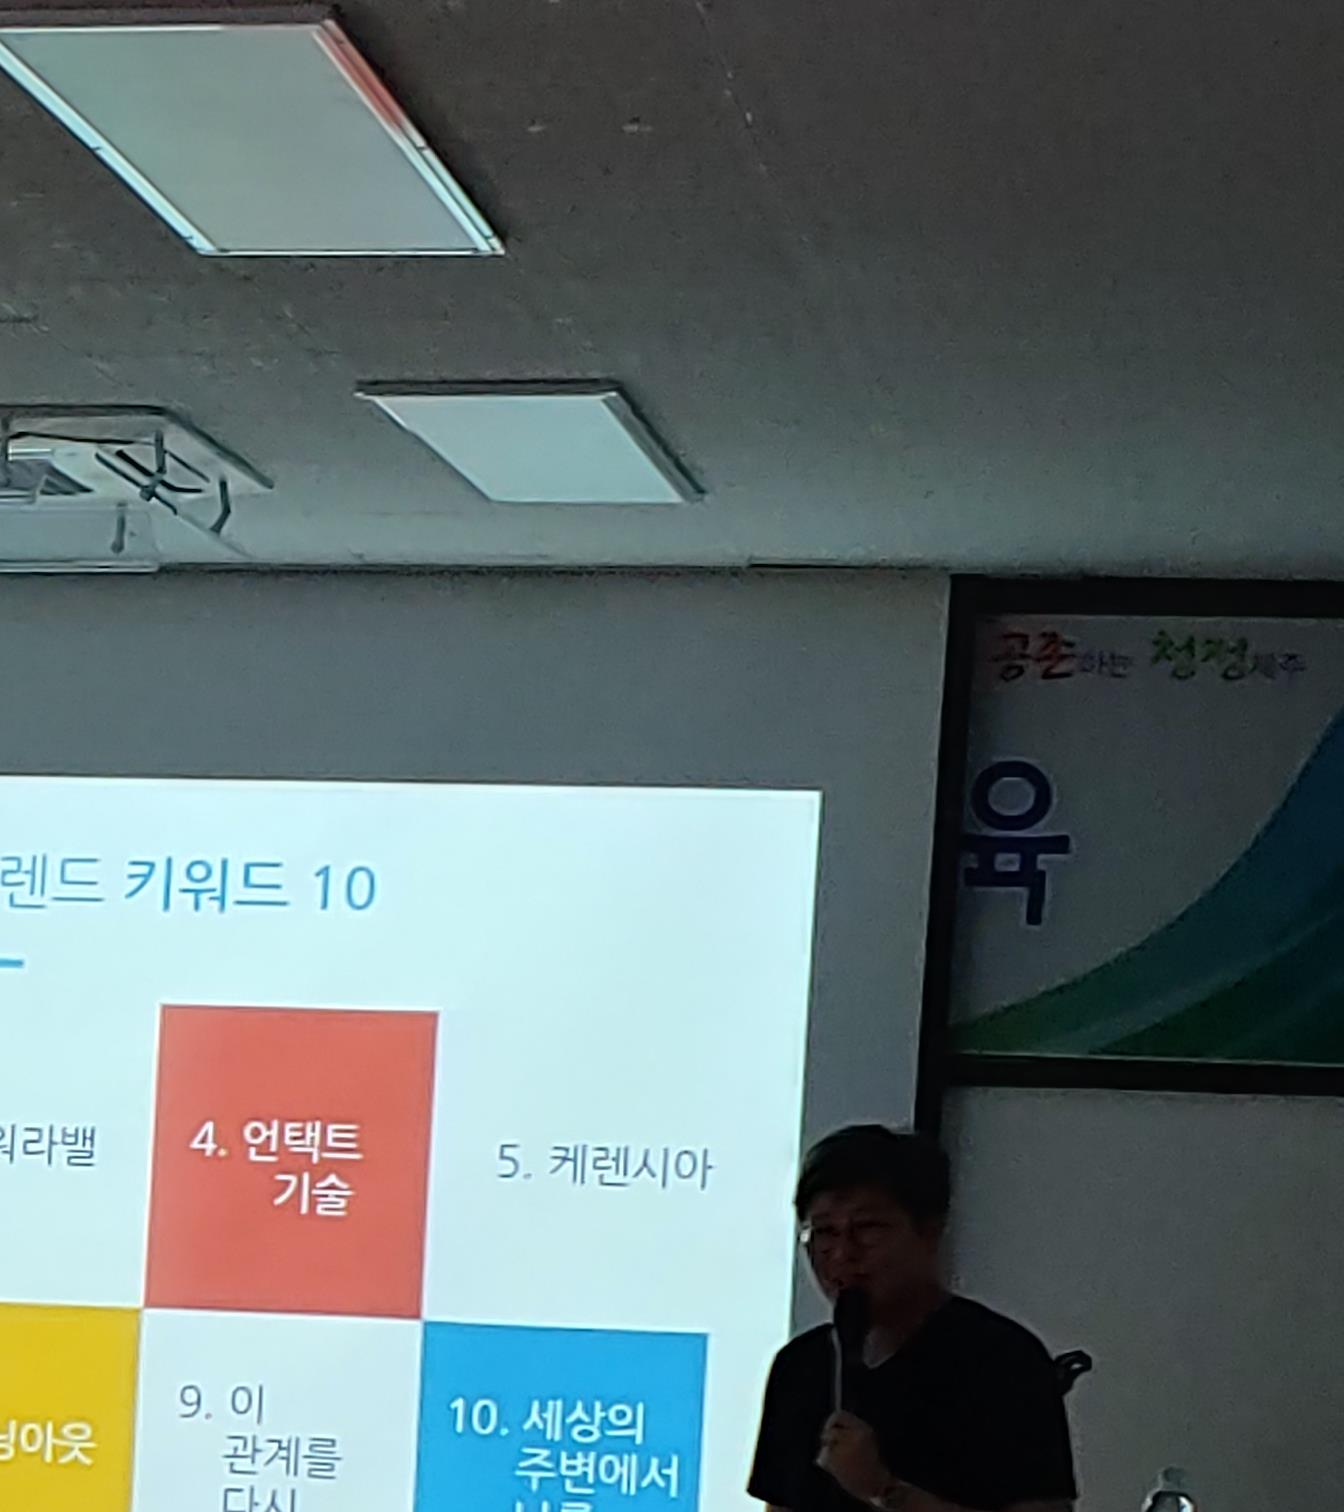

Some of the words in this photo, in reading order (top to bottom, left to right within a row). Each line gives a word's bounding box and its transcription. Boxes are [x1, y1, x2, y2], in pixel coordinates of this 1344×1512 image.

[124, 855, 290, 914] 키워드
[314, 864, 376, 911] 10
[189, 1120, 227, 1157] 4.
[243, 1119, 364, 1165] 언택트
[497, 1143, 532, 1179] 5.
[549, 1144, 714, 1191] 케렌시아
[273, 1171, 355, 1217] 기술
[179, 1384, 212, 1420] 9.
[230, 1384, 264, 1425] 이
[450, 1397, 510, 1438] 10.
[522, 1398, 646, 1447] 세상의
[221, 1434, 343, 1480] 관계를
[514, 1447, 679, 1498] 주변에서
